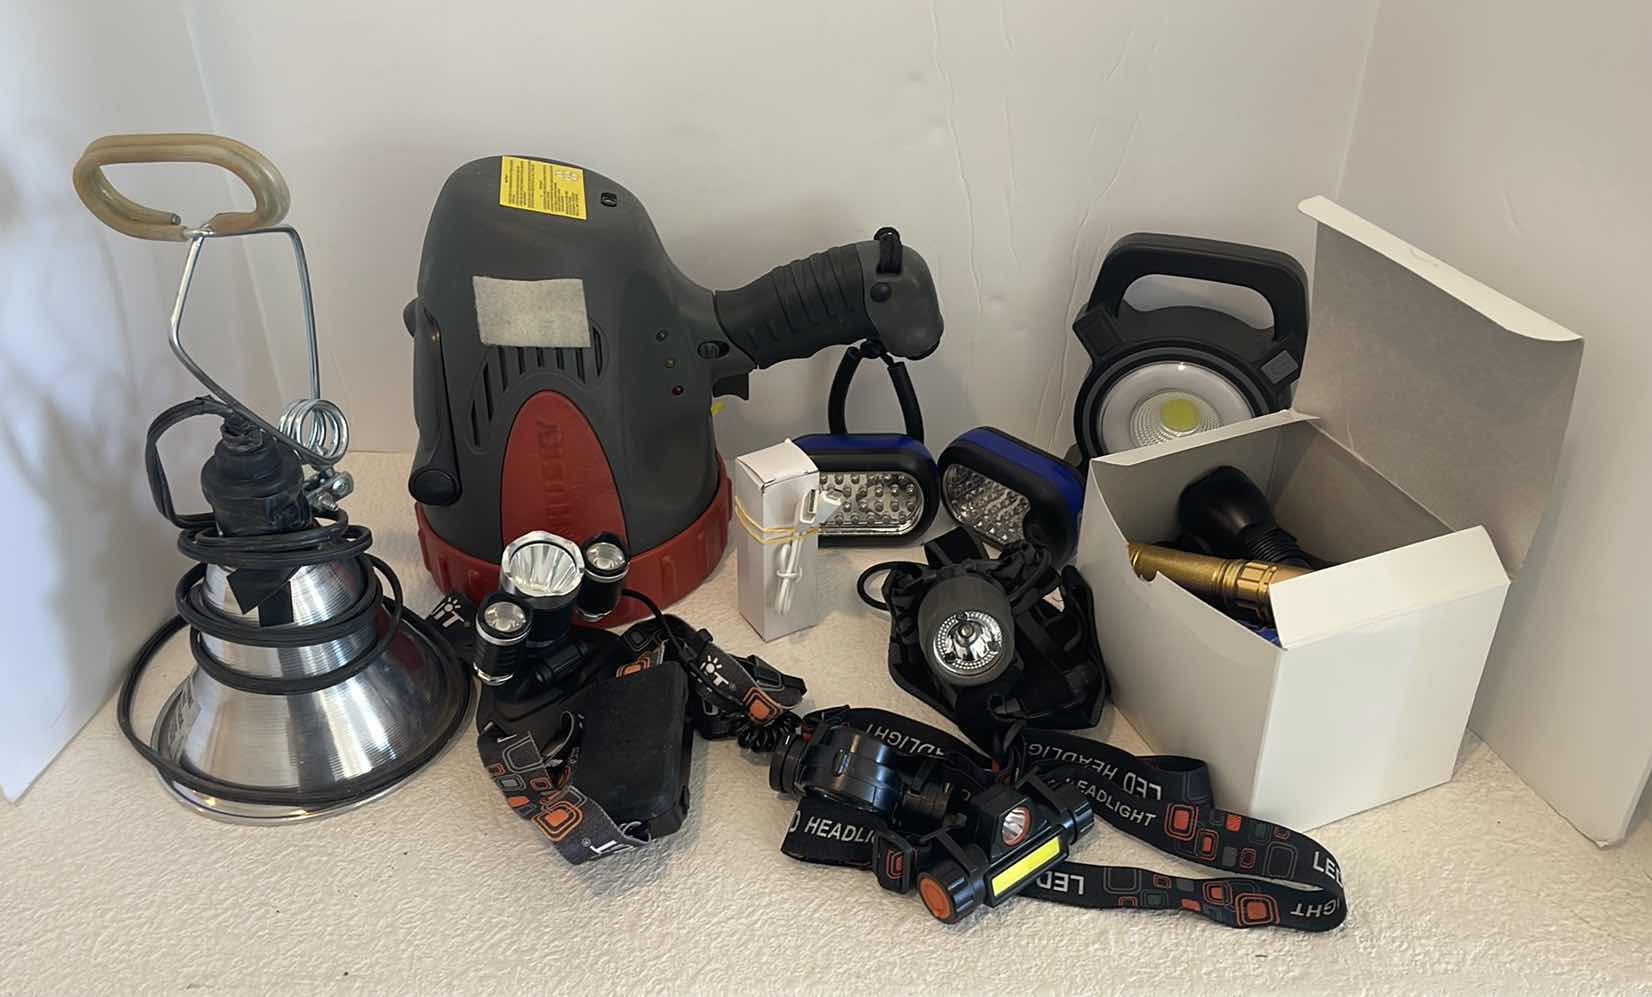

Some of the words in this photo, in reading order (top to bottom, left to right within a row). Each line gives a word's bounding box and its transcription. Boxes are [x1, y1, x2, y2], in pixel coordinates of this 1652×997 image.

[1025, 741, 1118, 781] HEADLIG
[1075, 779, 1157, 827] EADLIGHT
[1122, 771, 1162, 801] LED
[1035, 870, 1085, 896] LED
